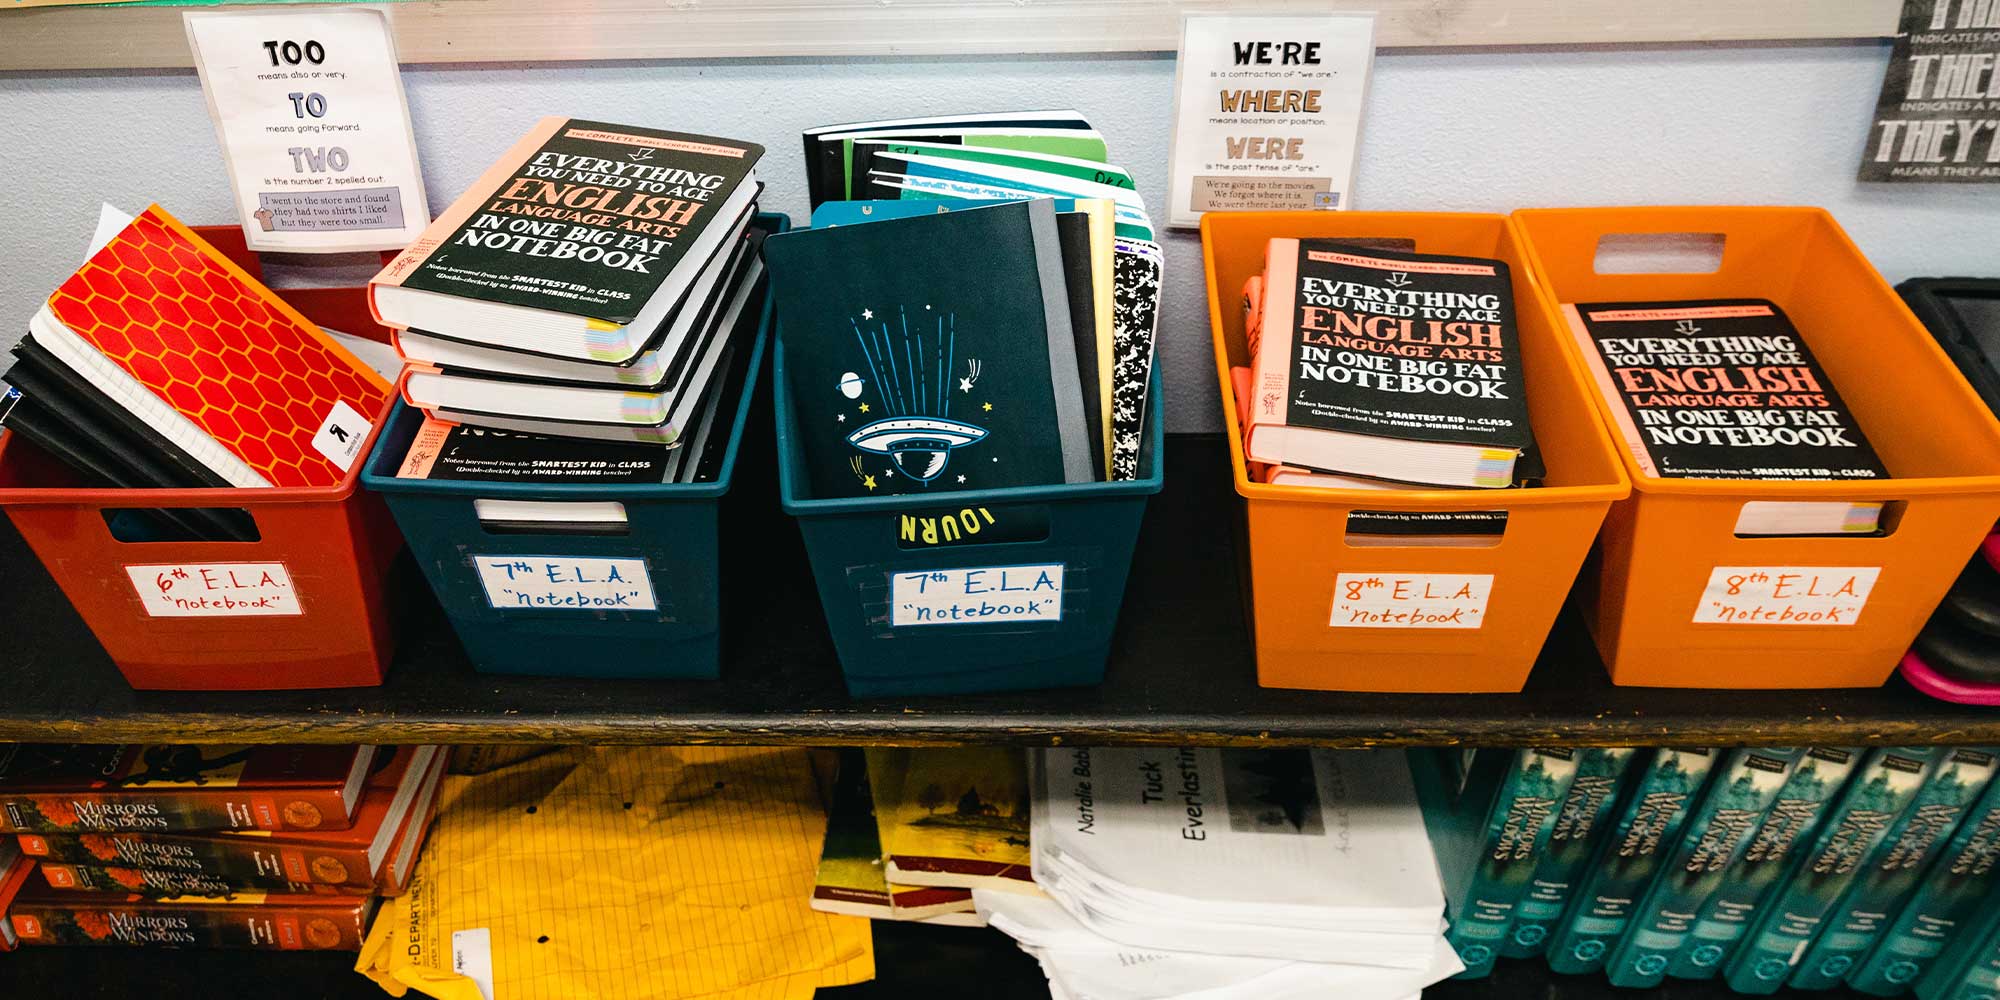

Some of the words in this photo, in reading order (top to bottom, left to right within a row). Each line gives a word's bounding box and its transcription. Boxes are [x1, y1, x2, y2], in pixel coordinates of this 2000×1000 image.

[1911, 33, 1979, 43] INDICATES
[263, 40, 325, 66] TOO
[1233, 42, 1320, 65] WE'RE
[291, 71, 308, 79] also
[325, 72, 347, 81] very.
[289, 92, 327, 118] TO
[1221, 90, 1321, 113] WHERE
[1901, 102, 1971, 111] INDICATES
[1974, 102, 1985, 110] A
[298, 124, 319, 133] going
[1291, 118, 1325, 126] position.
[1226, 137, 1304, 160] WERE
[288, 147, 349, 173] TWO
[1232, 164, 1252, 172] past
[335, 176, 365, 185] spelled
[368, 176, 386, 184] out.
[532, 152, 724, 190] EVERYTHING
[1891, 167, 1939, 175] MEANS
[1943, 167, 1976, 175] THEY
[526, 166, 570, 179] YOU
[576, 172, 631, 188] NEED
[637, 182, 664, 194] TO
[668, 186, 714, 202] ACE
[1206, 180, 1229, 188] We're
[1232, 181, 1255, 190] going
[1258, 181, 1266, 189] to
[1269, 181, 1282, 189] the
[1285, 182, 1315, 190] movies.
[272, 197, 291, 205] went
[293, 197, 302, 205] to
[304, 196, 318, 205] the
[321, 196, 343, 204] store
[345, 195, 361, 204] and
[364, 194, 390, 203] found
[499, 178, 704, 226] ENGLISH
[1214, 190, 1226, 198] We
[1230, 190, 1254, 200] forgot
[1257, 191, 1283, 199] where
[1286, 191, 1292, 199] it
[274, 208, 293, 217] they
[296, 207, 311, 216] had
[332, 206, 356, 215] shirts
[366, 205, 387, 213] liked
[489, 202, 615, 227] LANGUAGE
[617, 220, 682, 238] ARTS
[281, 219, 296, 227] but
[299, 218, 317, 228] they
[320, 218, 340, 226] were
[360, 216, 385, 224] small.
[471, 214, 508, 229] IN
[510, 219, 567, 236] ONE
[567, 228, 614, 245] BIG
[617, 236, 672, 255] FAT
[455, 230, 660, 274] NOTEBOOK
[1303, 277, 1500, 309] EVERYTHING
[1302, 293, 1348, 308] YOU
[1354, 300, 1415, 317] NEED
[1420, 307, 1452, 319] TO
[1456, 310, 1500, 322] ACE
[1301, 307, 1503, 348] ENGLISH
[1303, 331, 1432, 358] LANGUAGE
[1440, 349, 1502, 361] ARTS
[1599, 336, 1796, 353] EVERYTHING
[1301, 345, 1332, 362] IN
[1337, 351, 1393, 372] ONE
[1400, 359, 1448, 376] BIG
[1453, 362, 1506, 379] FAT
[1608, 353, 1654, 366] YOU
[1659, 353, 1721, 365] NEED
[1723, 353, 1757, 365] TO
[1761, 352, 1806, 365] ACE
[1300, 362, 1509, 399] NOTEBOOK
[1615, 367, 1823, 392] ENGLISH
[1635, 394, 1763, 407] LANGUAGE
[1768, 395, 1830, 407] ARTS
[1638, 409, 1671, 425] IN
[1675, 410, 1734, 425] ONE
[1736, 410, 1785, 426] BIG
[1786, 410, 1840, 426] FAT
[1645, 427, 1858, 446] NOTEBOOK
[532, 460, 588, 468] SMARTEST
[157, 568, 189, 592] 6th
[199, 568, 285, 592] E.L.A.
[490, 561, 533, 580] 7th
[546, 564, 632, 584] E.L.A.
[905, 571, 948, 594] 7th
[964, 570, 1059, 594] E.L.A.
[1345, 578, 1384, 600] 8th
[1392, 580, 1477, 600] E.L.A.
[1726, 572, 1769, 595] 8th
[1772, 574, 1859, 598] E.L.A.
[163, 596, 280, 610] "notebook"
[504, 589, 638, 607] "notebook"
[903, 599, 1053, 621] "notebook"
[1341, 606, 1479, 625] "notebook"
[1712, 602, 1855, 622] "notebook"
[1138, 761, 1163, 804] Tuck
[73, 801, 159, 815] MIRRORS
[1074, 781, 1095, 835] Natalie
[78, 814, 168, 827] WINDOWS
[114, 837, 194, 856] MIRRORS
[118, 851, 201, 869] WINDOWS
[109, 912, 187, 928] MIRRORS
[112, 927, 195, 942] WINDOWS
